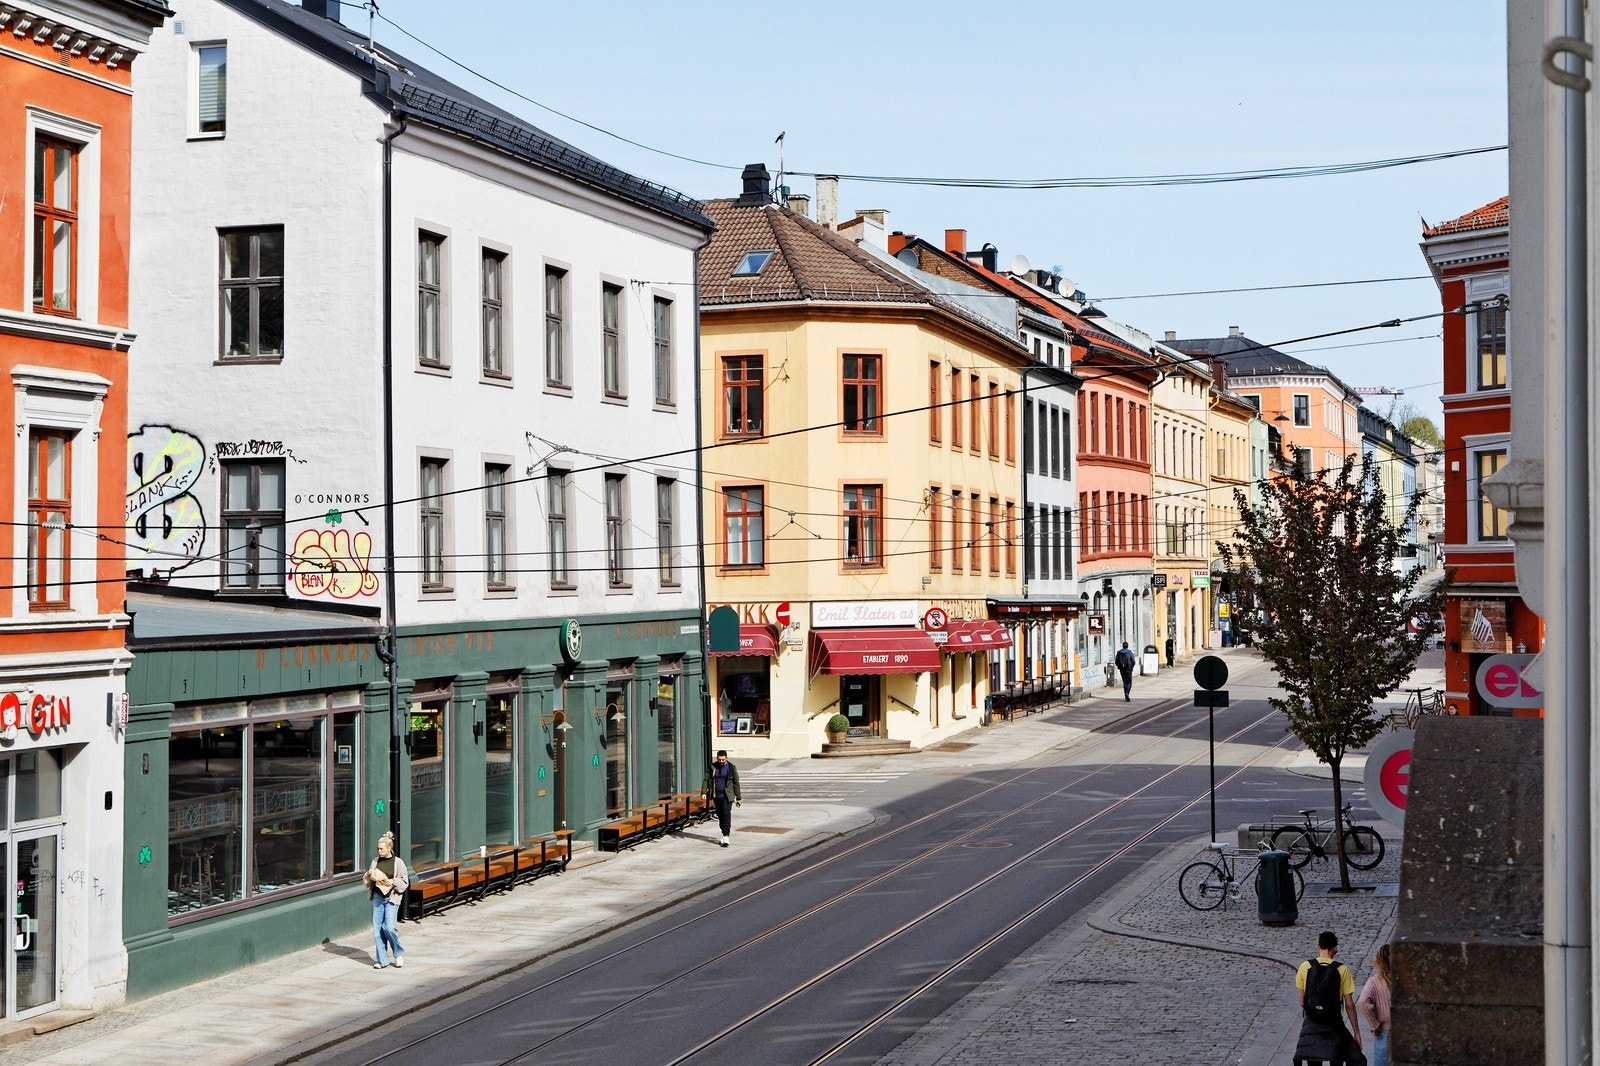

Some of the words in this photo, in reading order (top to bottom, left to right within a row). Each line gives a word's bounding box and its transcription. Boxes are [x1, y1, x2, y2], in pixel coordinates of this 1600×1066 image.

[818, 607, 849, 621] Emil
[854, 606, 896, 620] Flaten
[900, 609, 914, 619] as
[862, 654, 889, 663] ETABLERT
[894, 654, 909, 663] 1890
